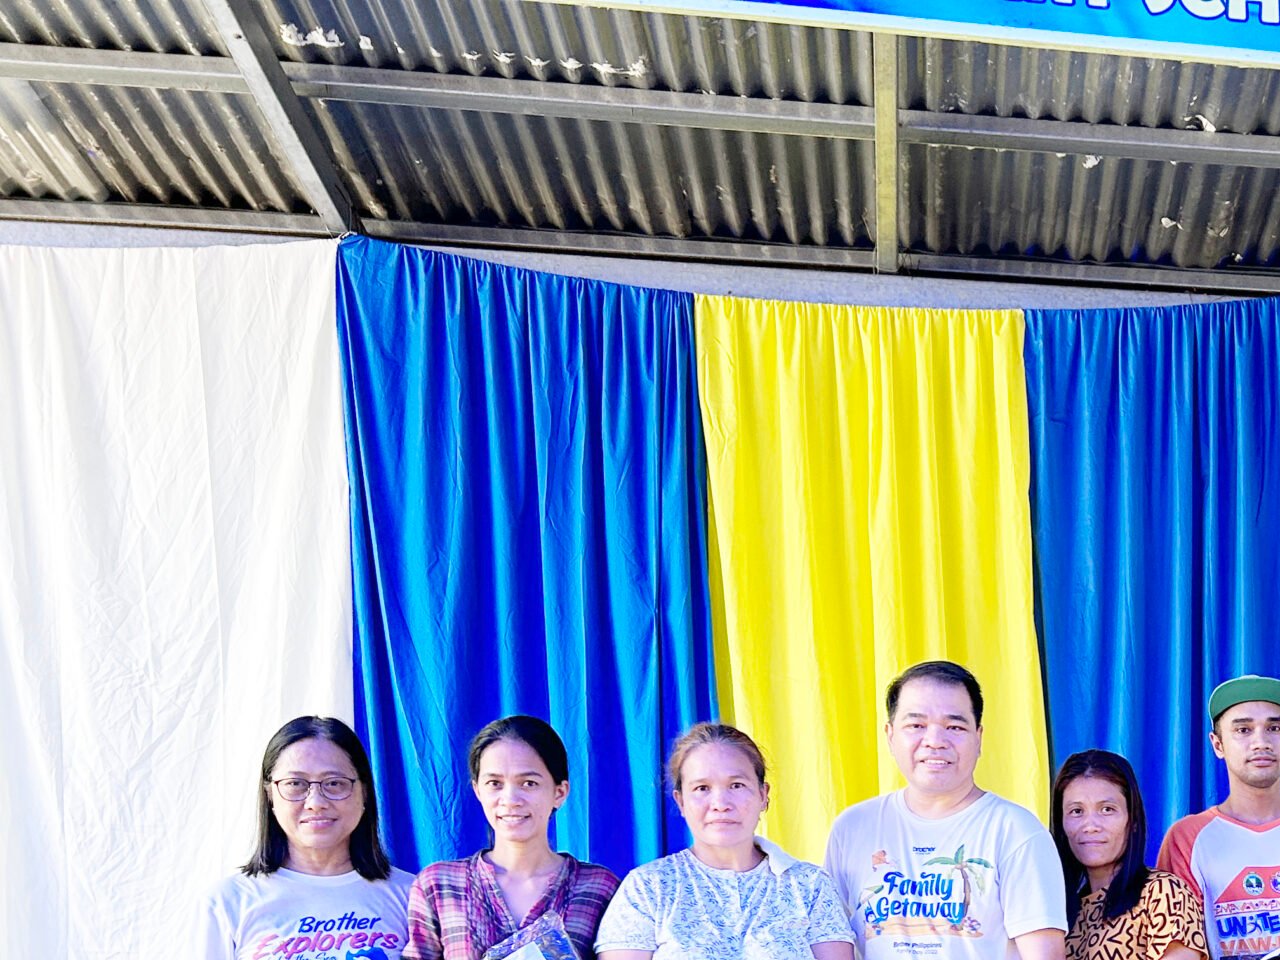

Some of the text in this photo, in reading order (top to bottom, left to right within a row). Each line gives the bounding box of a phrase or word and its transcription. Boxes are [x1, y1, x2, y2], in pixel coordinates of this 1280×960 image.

[883, 872, 954, 900] Family
[298, 911, 381, 933] Brother
[873, 897, 964, 924] Getaway
[252, 930, 399, 960] Explorers
